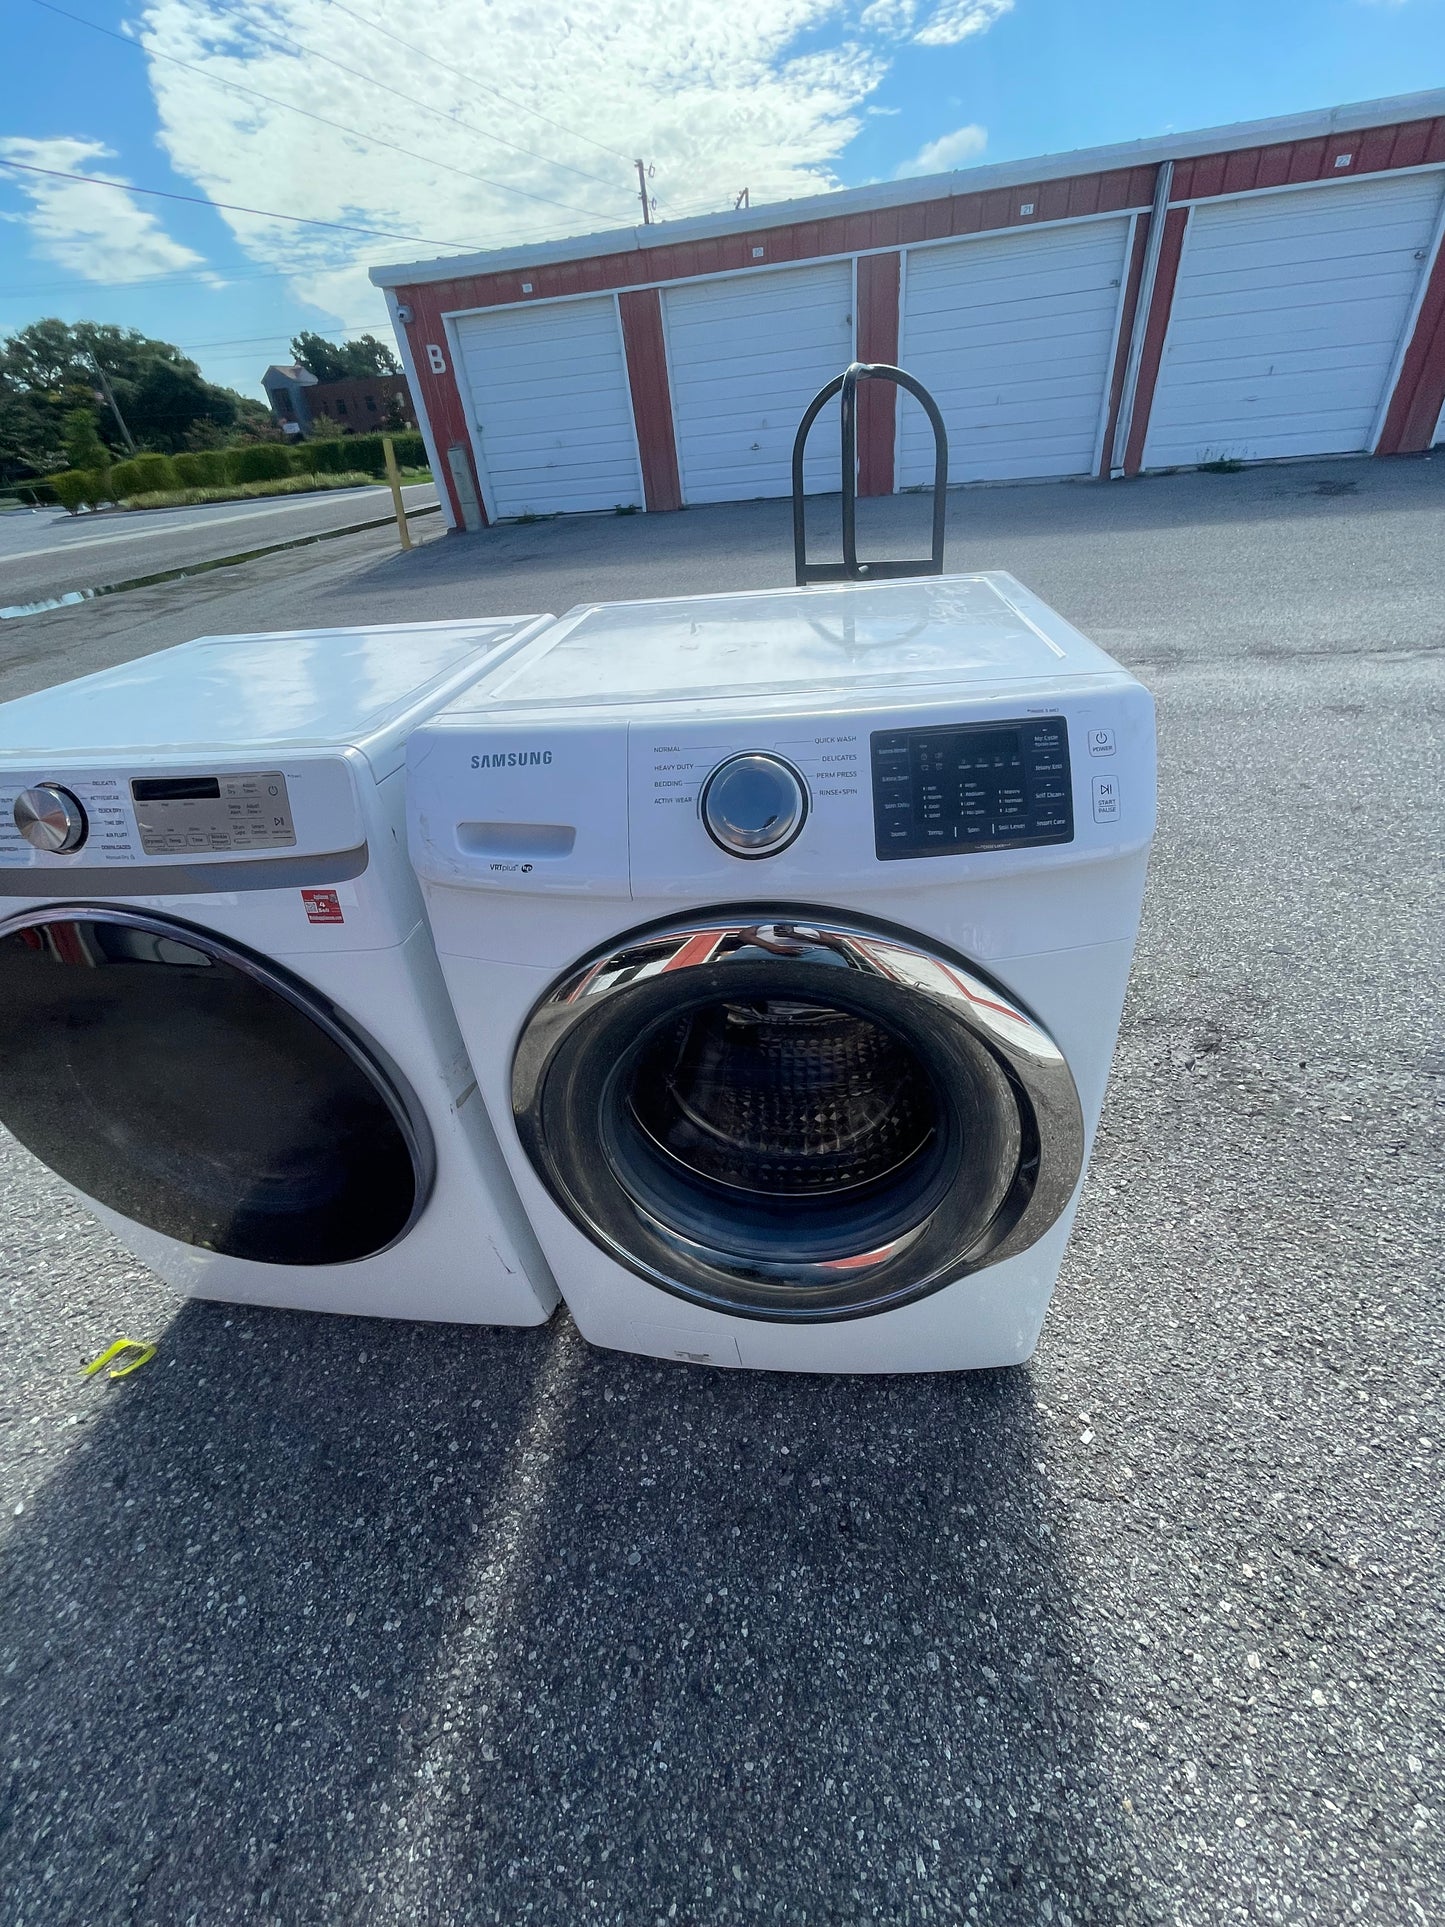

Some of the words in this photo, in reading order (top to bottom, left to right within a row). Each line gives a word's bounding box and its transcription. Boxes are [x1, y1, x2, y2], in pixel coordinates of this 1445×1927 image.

[1337, 156, 1349, 166] 22
[1023, 205, 1031, 214] 21
[425, 344, 447, 375] B
[814, 736, 835, 744] QUICK
[836, 735, 857, 743] WASH
[653, 745, 681, 753] NORMAL
[470, 750, 553, 769] SAMSUNG
[821, 754, 857, 762] DELICATES
[836, 770, 858, 778] PRESS
[654, 780, 683, 788] BEDDING
[1098, 806, 1116, 814] PAUSE
